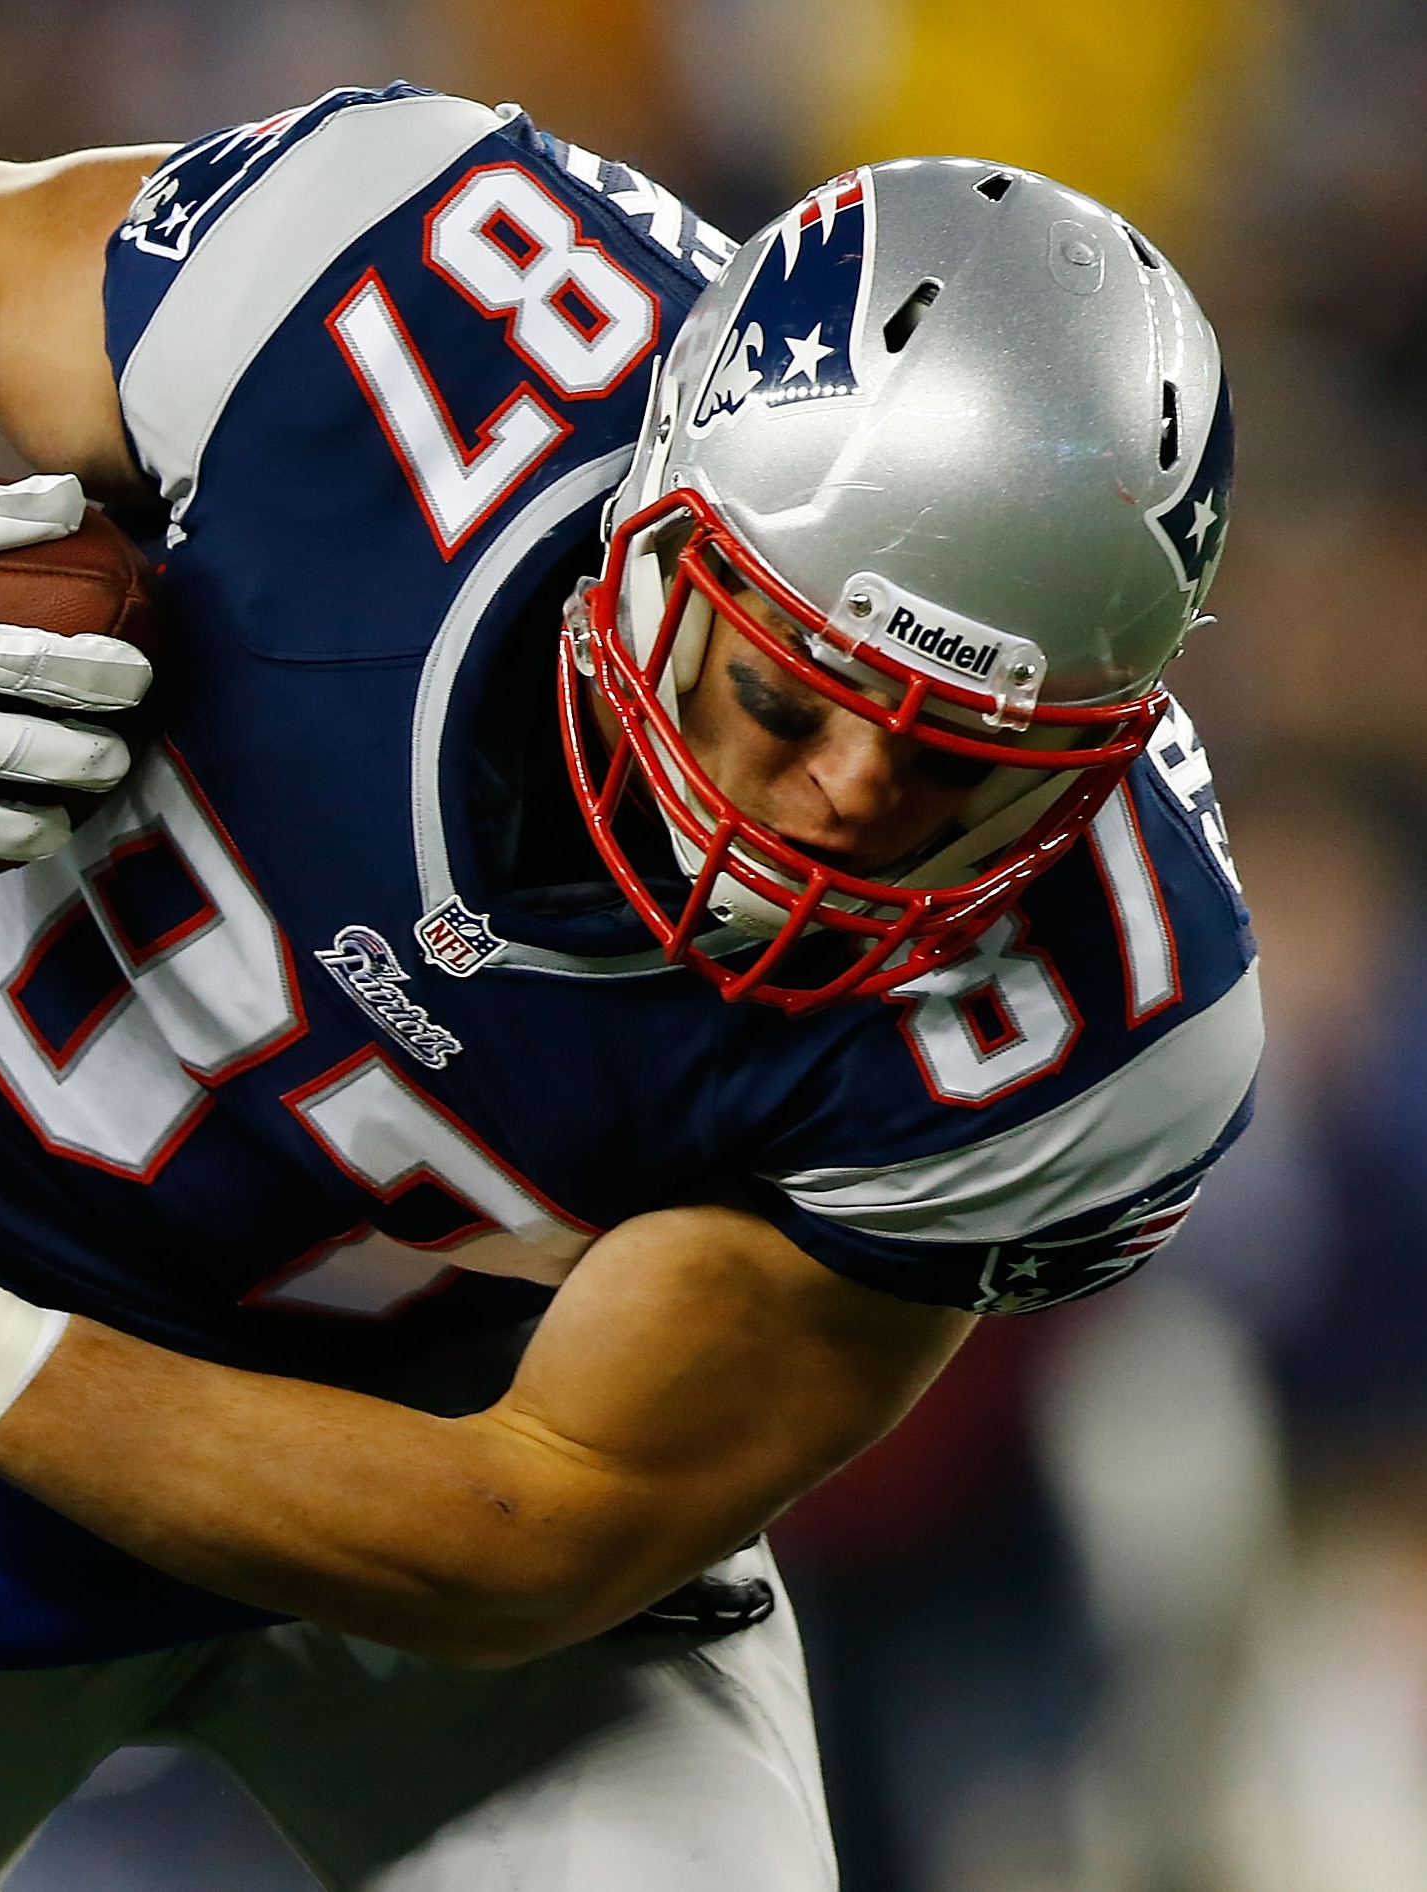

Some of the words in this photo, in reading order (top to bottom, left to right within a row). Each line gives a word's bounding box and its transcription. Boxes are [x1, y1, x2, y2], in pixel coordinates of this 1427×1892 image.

[324, 160, 661, 562] 87
[885, 605, 1000, 676] Riddell
[423, 919, 474, 969] NFL
[314, 934, 464, 1070] Patriots
